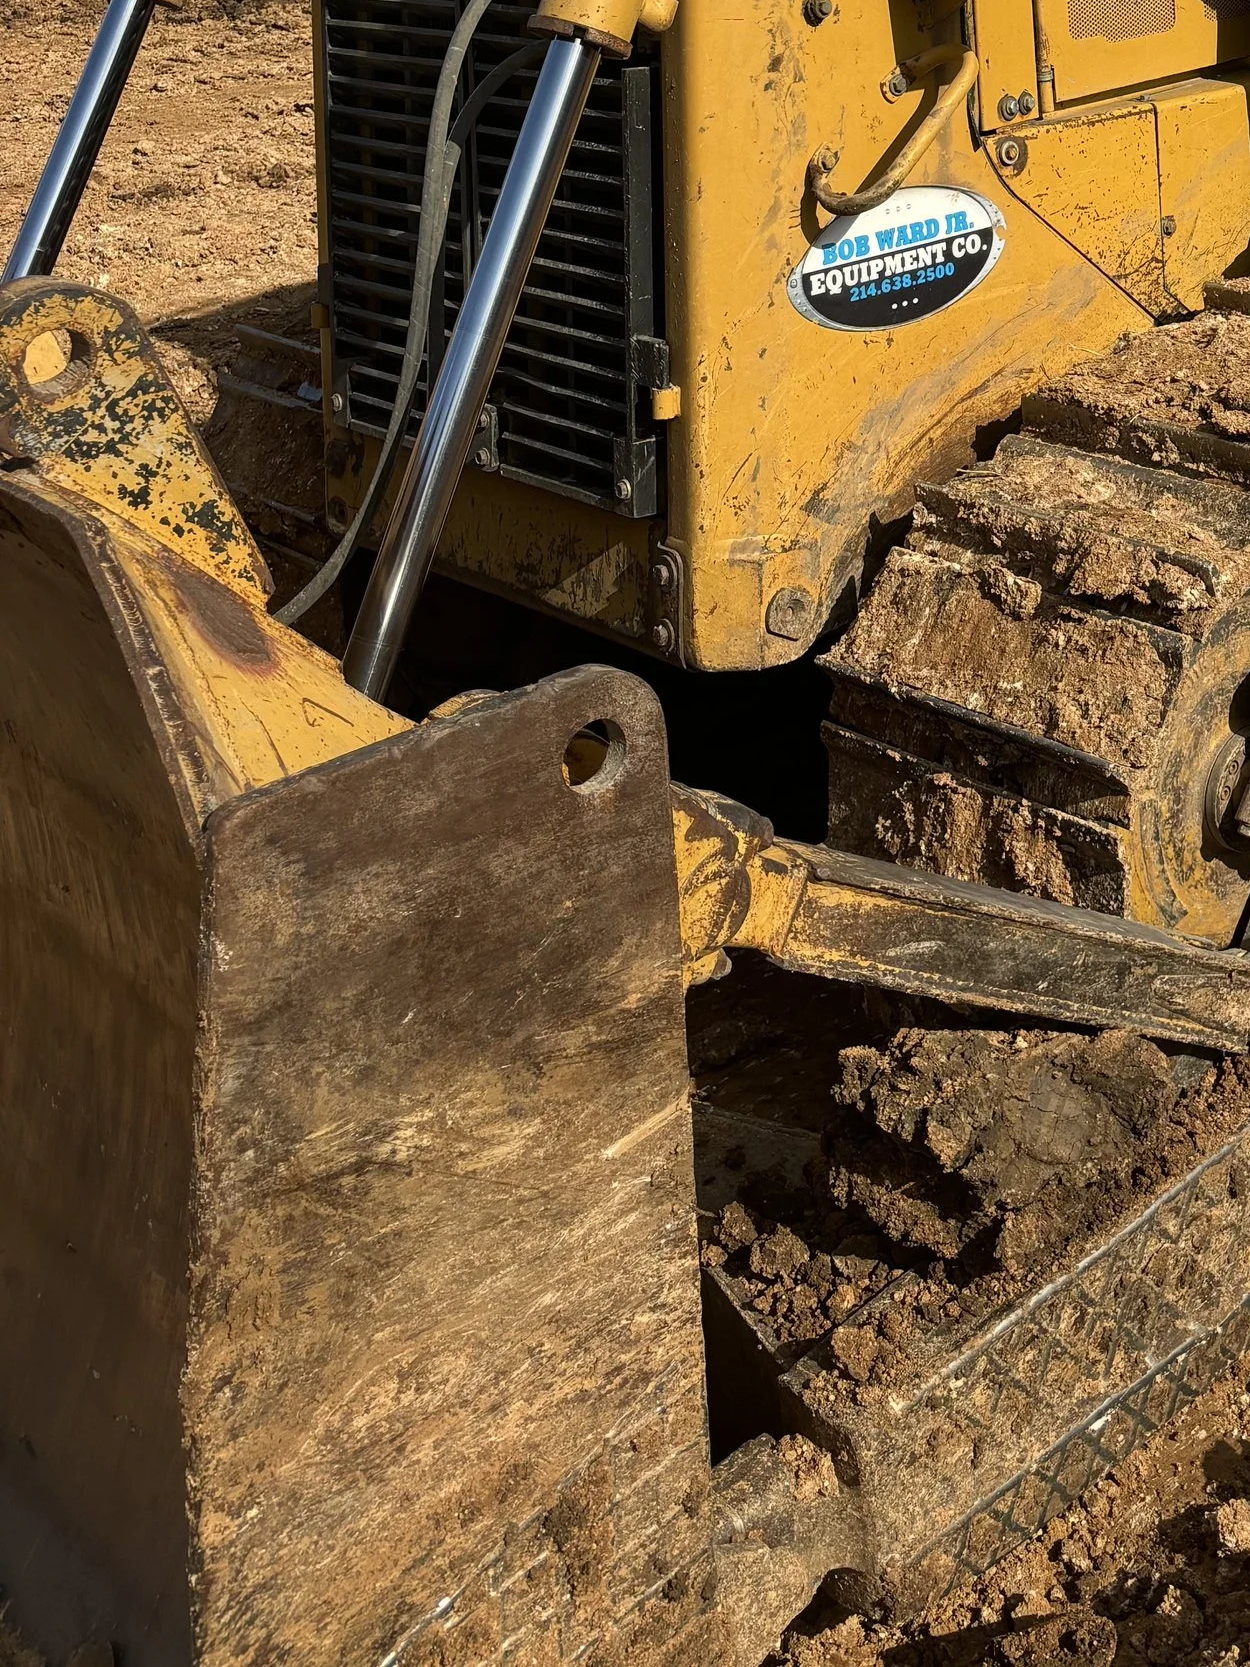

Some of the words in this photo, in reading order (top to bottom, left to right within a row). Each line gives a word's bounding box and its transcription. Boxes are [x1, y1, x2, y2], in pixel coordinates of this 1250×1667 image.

[809, 242, 947, 296] EQUIPMENT
[952, 234, 988, 258] CO.
[822, 234, 870, 265] BOB
[875, 218, 940, 251] WARD
[945, 211, 975, 234] JR.
[849, 262, 955, 302] 214.638.2500
